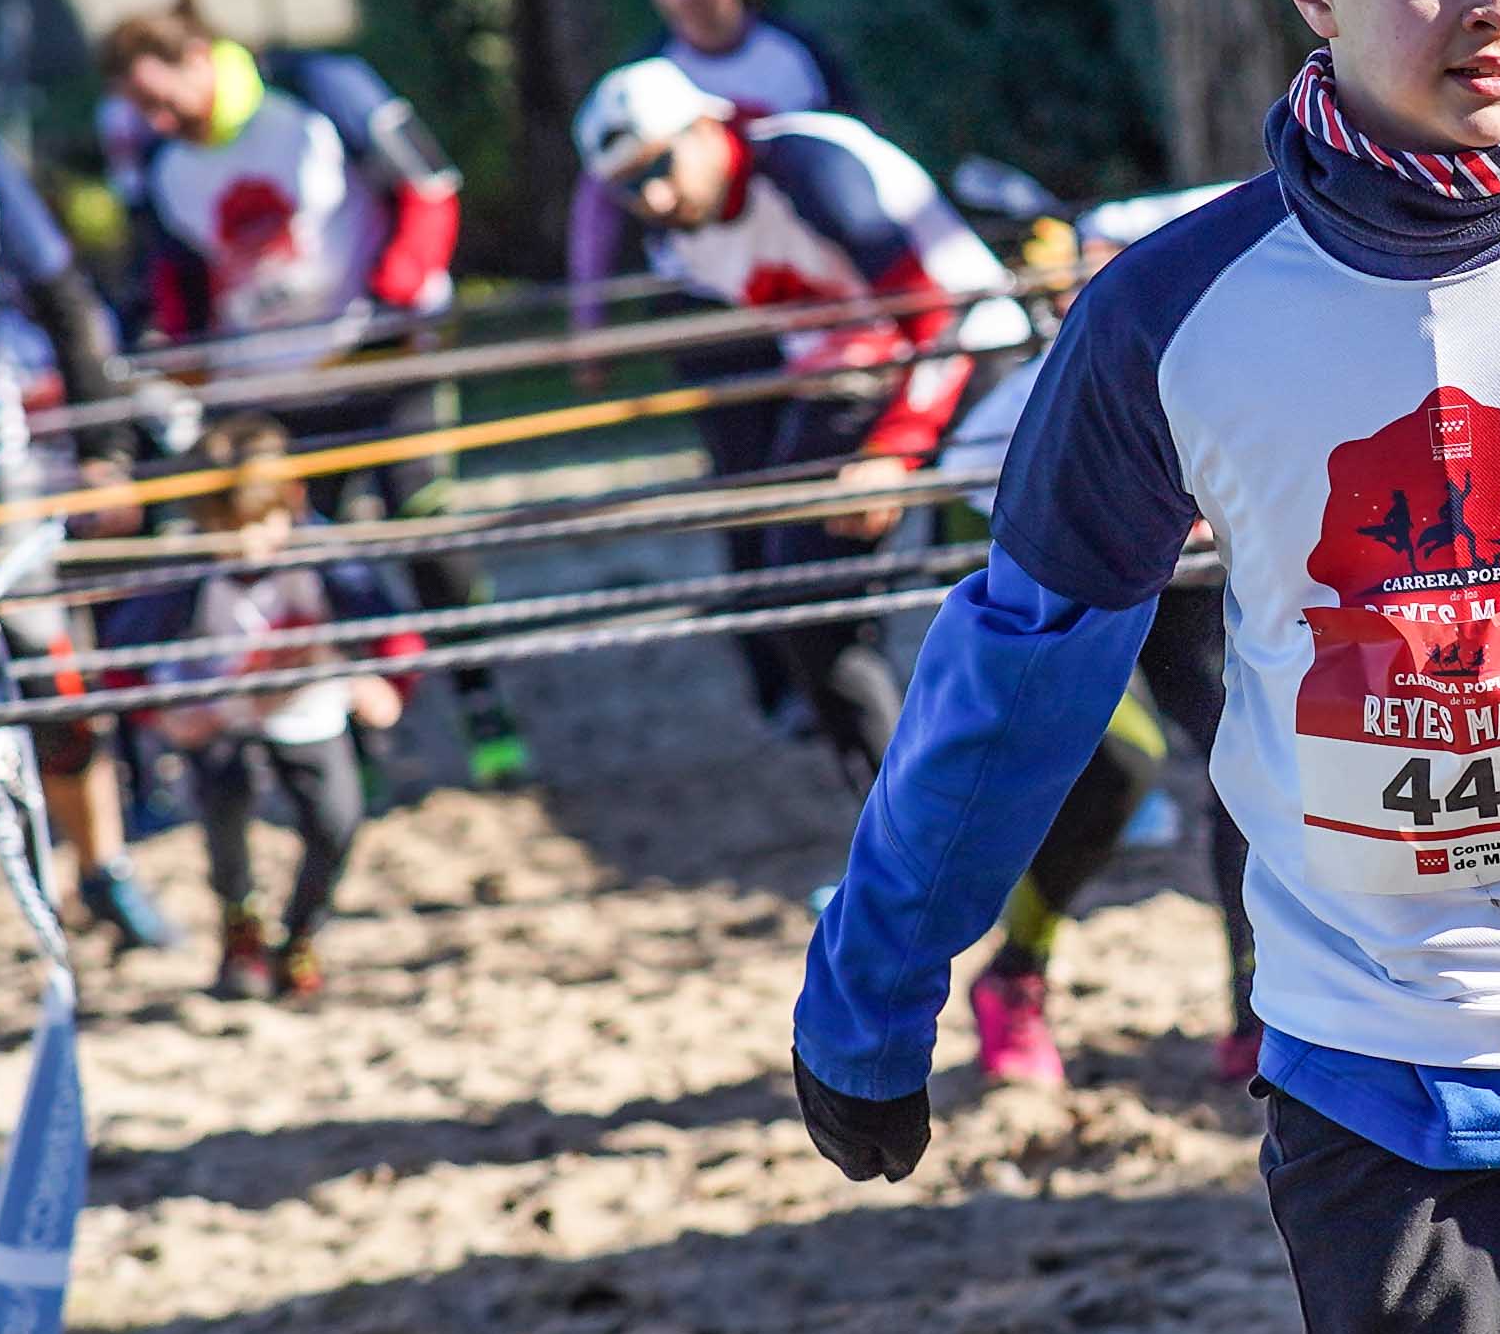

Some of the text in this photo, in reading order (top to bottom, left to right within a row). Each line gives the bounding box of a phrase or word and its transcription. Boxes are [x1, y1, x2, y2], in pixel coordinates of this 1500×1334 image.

[1383, 572, 1462, 592] CARRERA
[1450, 590, 1478, 601] de los
[1394, 673, 1459, 694] CARRERA
[1450, 697, 1476, 705] de los
[1363, 694, 1454, 743] REYES
[1454, 859, 1477, 871] de
